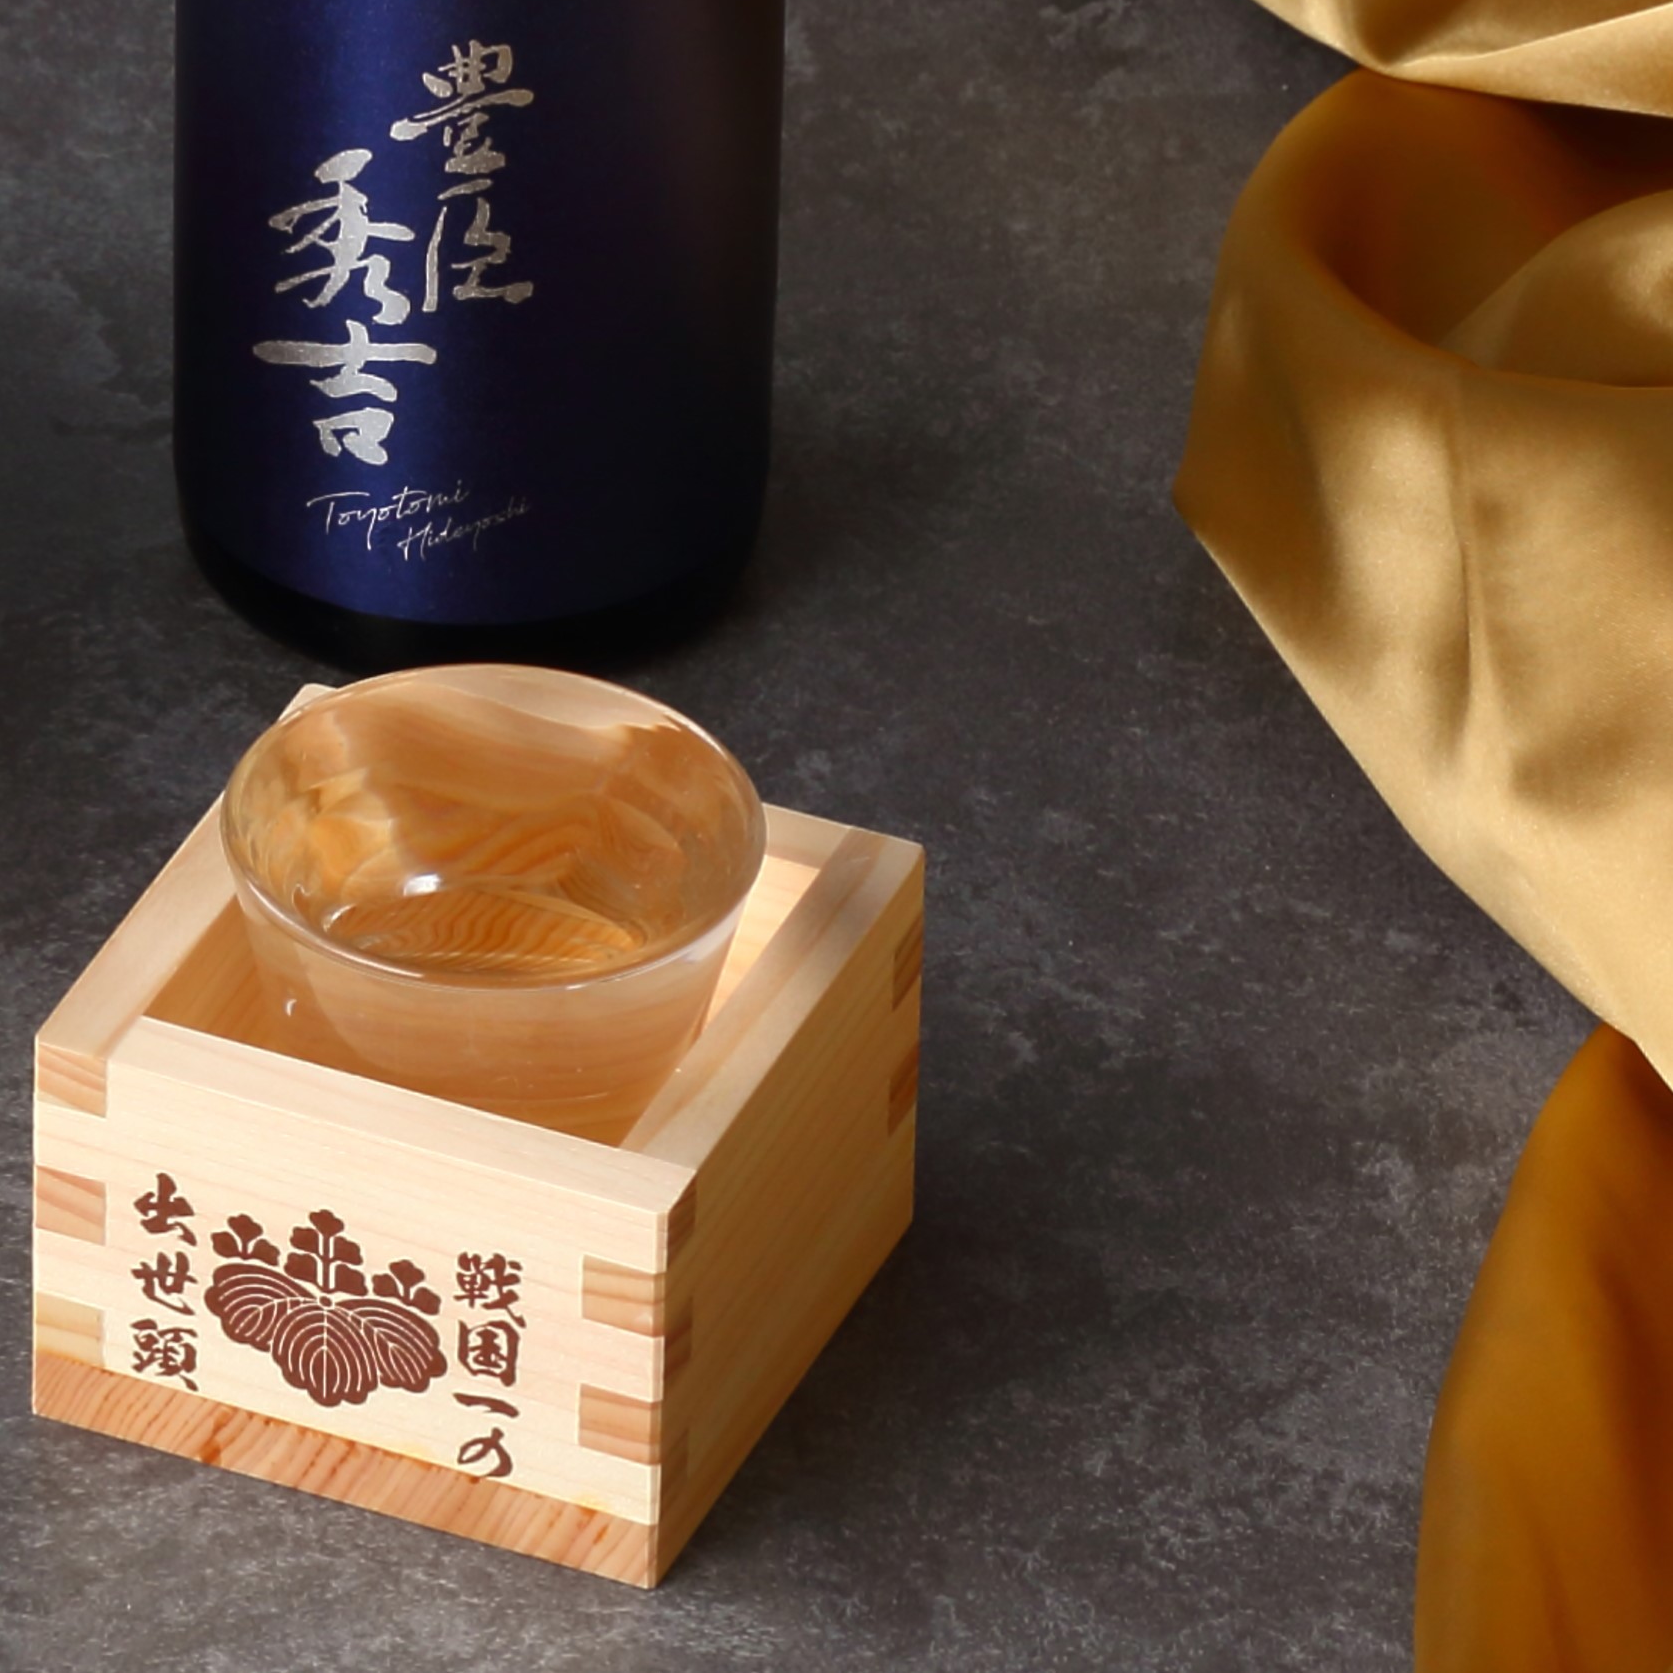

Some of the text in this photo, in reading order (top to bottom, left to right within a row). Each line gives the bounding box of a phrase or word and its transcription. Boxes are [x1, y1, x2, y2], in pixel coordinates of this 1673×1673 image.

[306, 480, 469, 551] Toyotomi
[397, 496, 531, 561] Hideyoshi
[131, 1172, 198, 1392] 出世頭
[453, 1252, 526, 1477] 戦国一の
